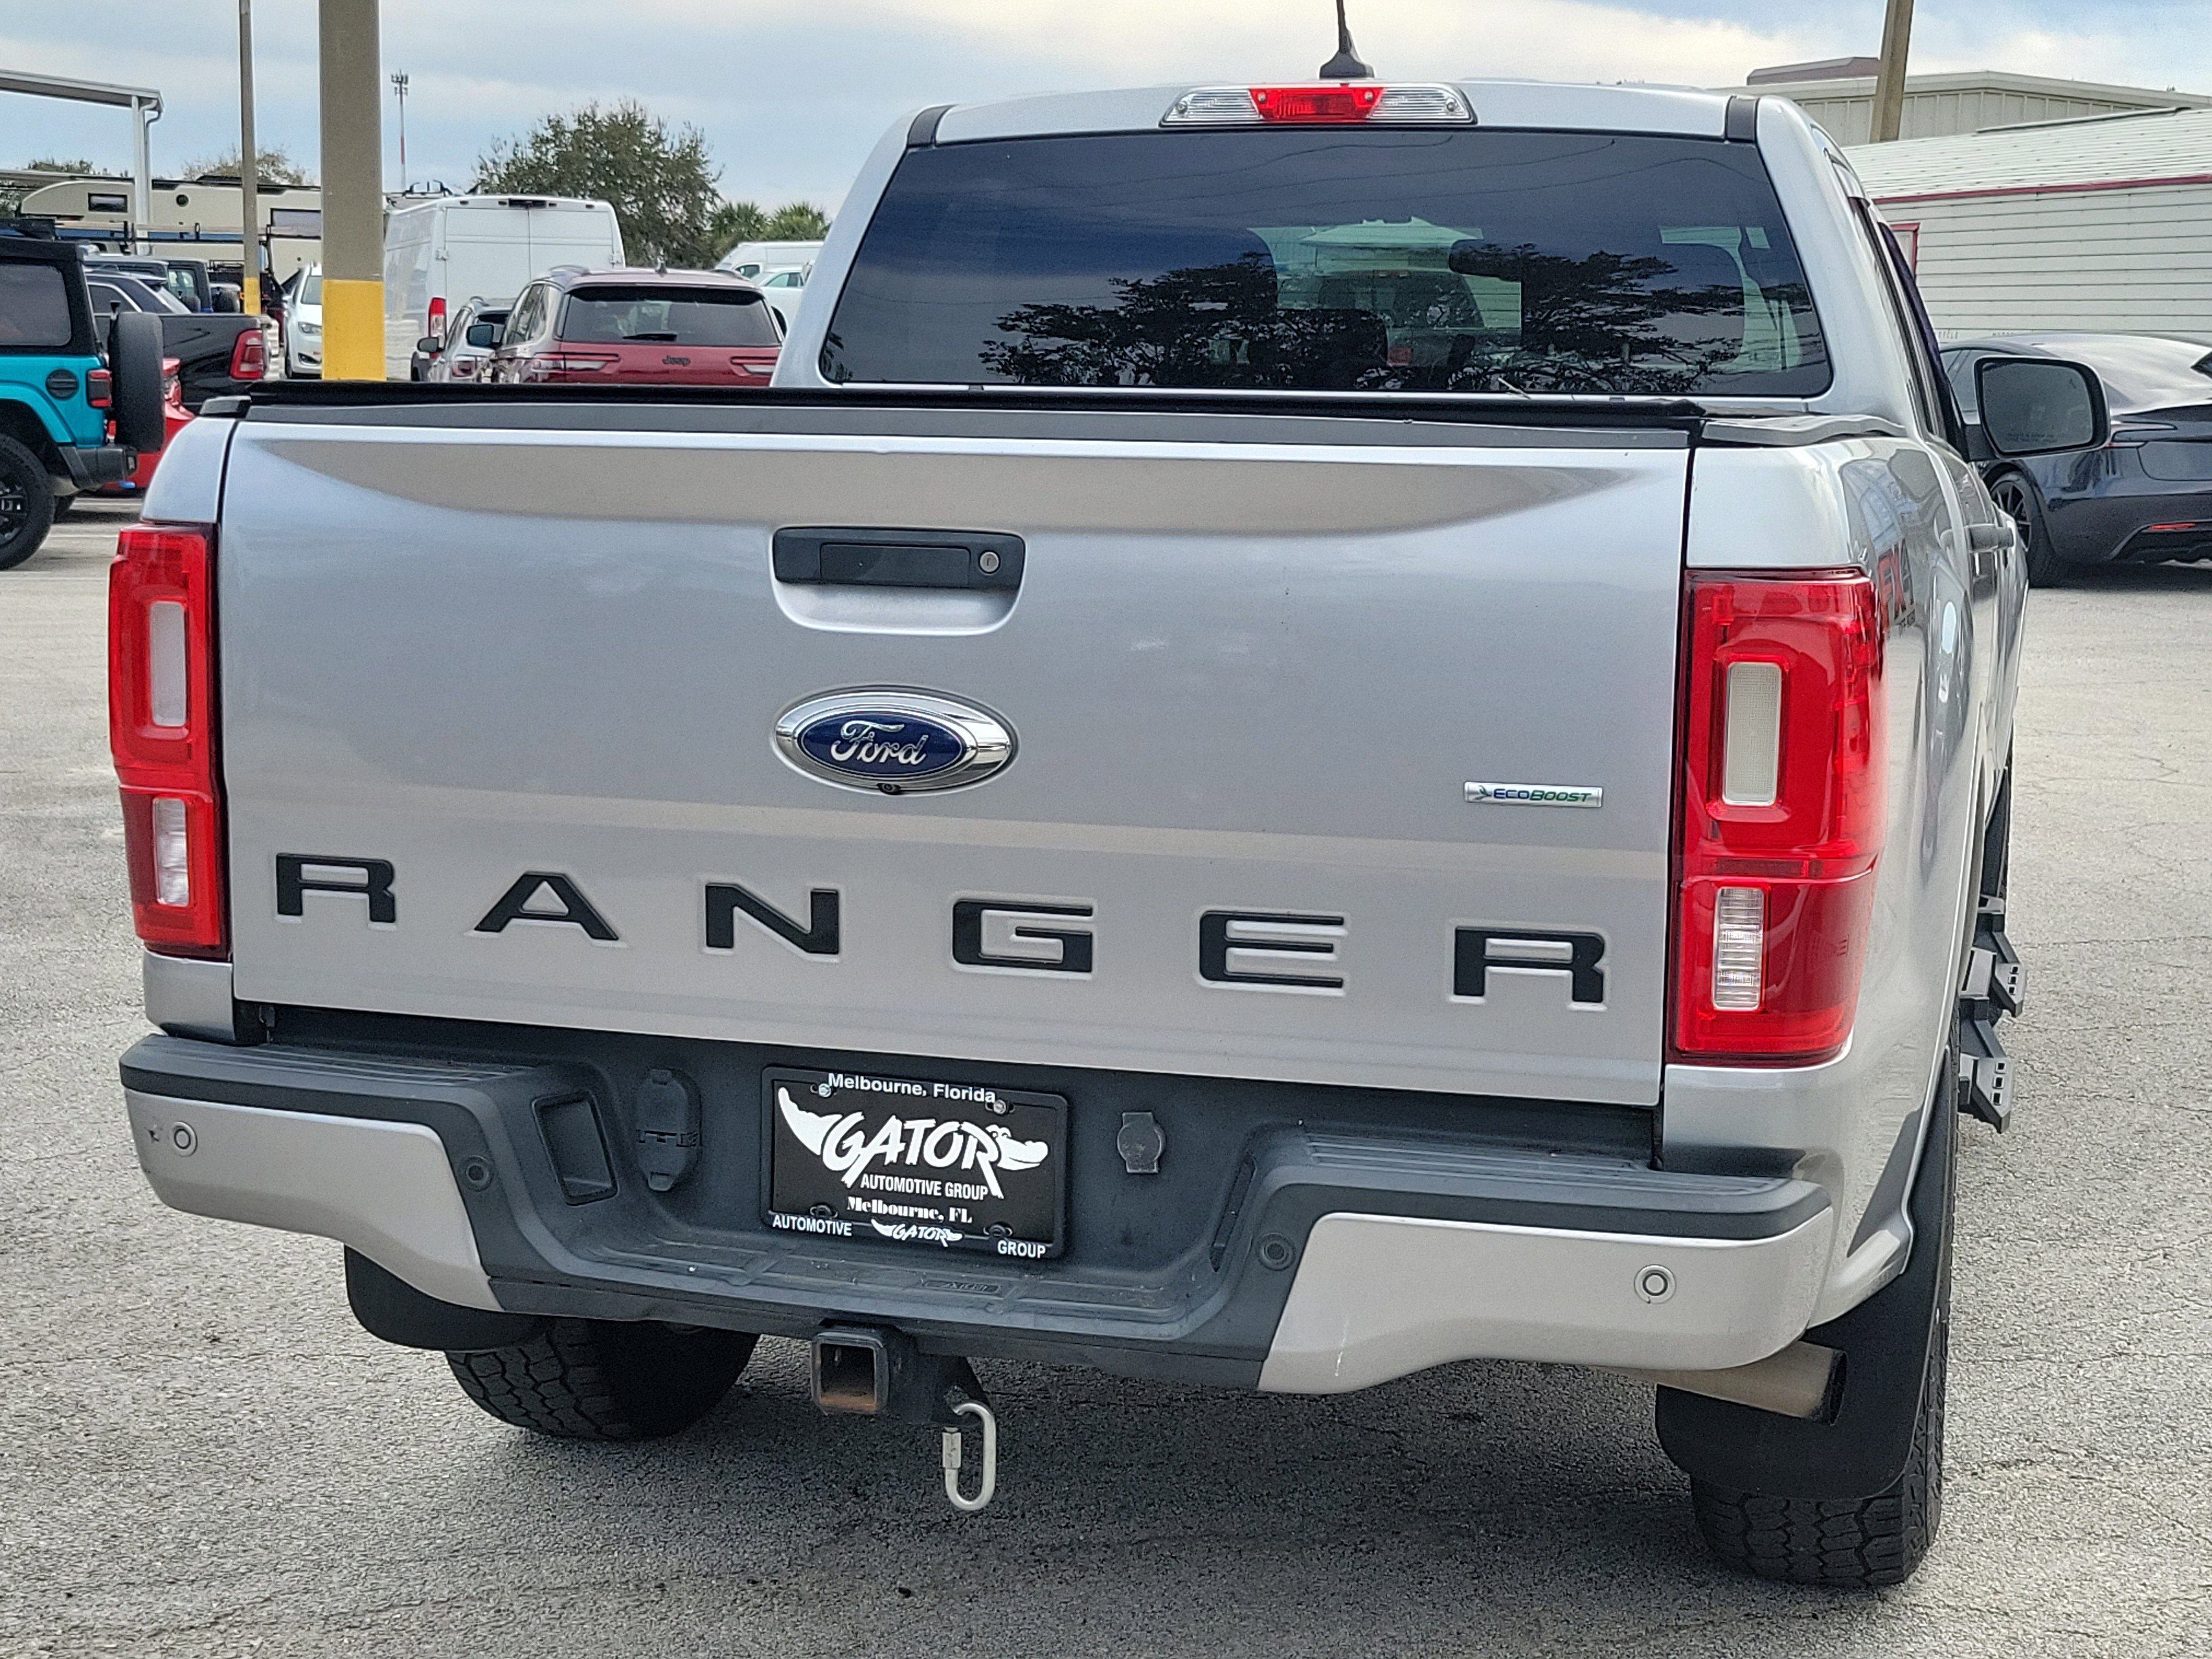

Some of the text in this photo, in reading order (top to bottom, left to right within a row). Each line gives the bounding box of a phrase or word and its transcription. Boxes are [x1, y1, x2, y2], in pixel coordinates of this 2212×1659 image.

[831, 720, 929, 765] Ford
[1493, 788, 1592, 802] ECOBOOST
[275, 853, 1606, 1005] RANGER
[828, 1073, 996, 1103] Melbourne, Florida
[823, 1112, 1004, 1198] GATOR
[861, 1174, 988, 1200] AUTOMOTIVE GROUP
[847, 1197, 973, 1223] Melbourne, FL
[772, 1214, 852, 1237] AUTOMOTIVE
[893, 1223, 949, 1247] GATOR
[997, 1239, 1046, 1259] GROUP
